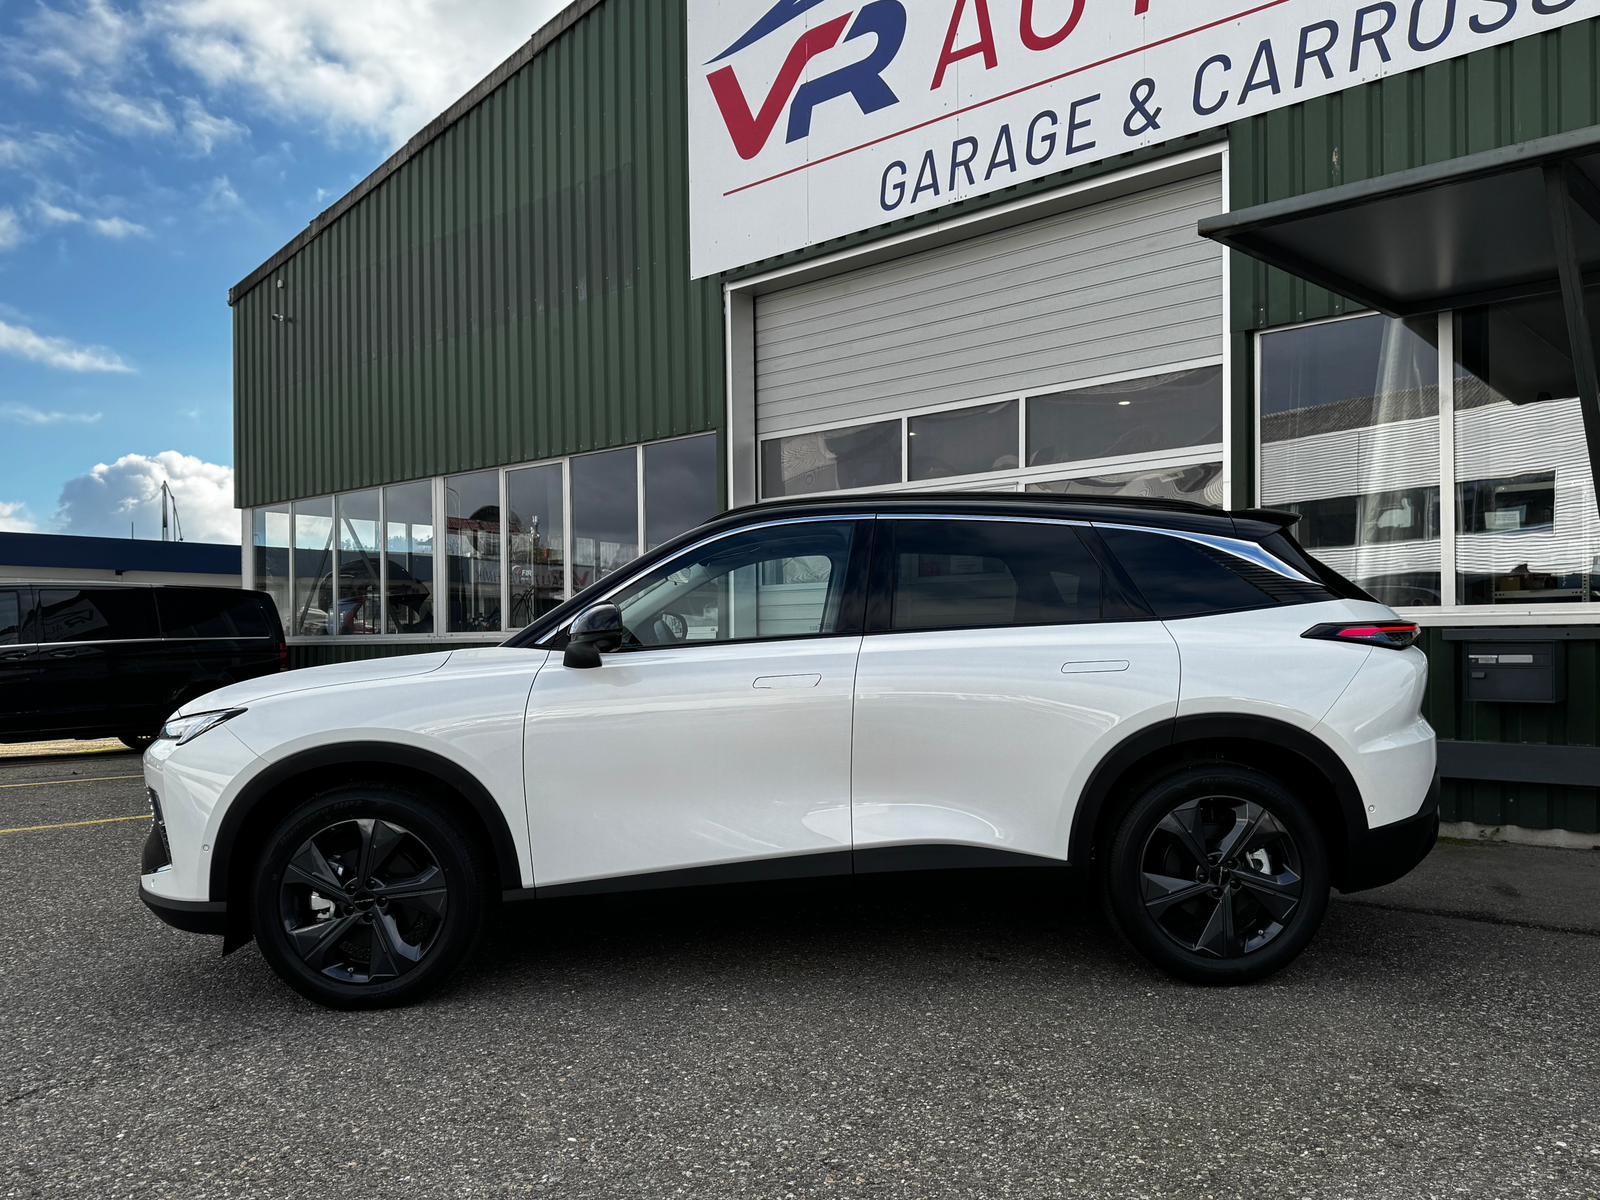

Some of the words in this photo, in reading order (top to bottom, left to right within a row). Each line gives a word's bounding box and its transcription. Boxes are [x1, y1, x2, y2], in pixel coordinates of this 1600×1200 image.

[879, 93, 1101, 211] GARAGE
[1122, 77, 1162, 137] &
[1192, 0, 1576, 116] CARROS
[930, 0, 1149, 90] AU
